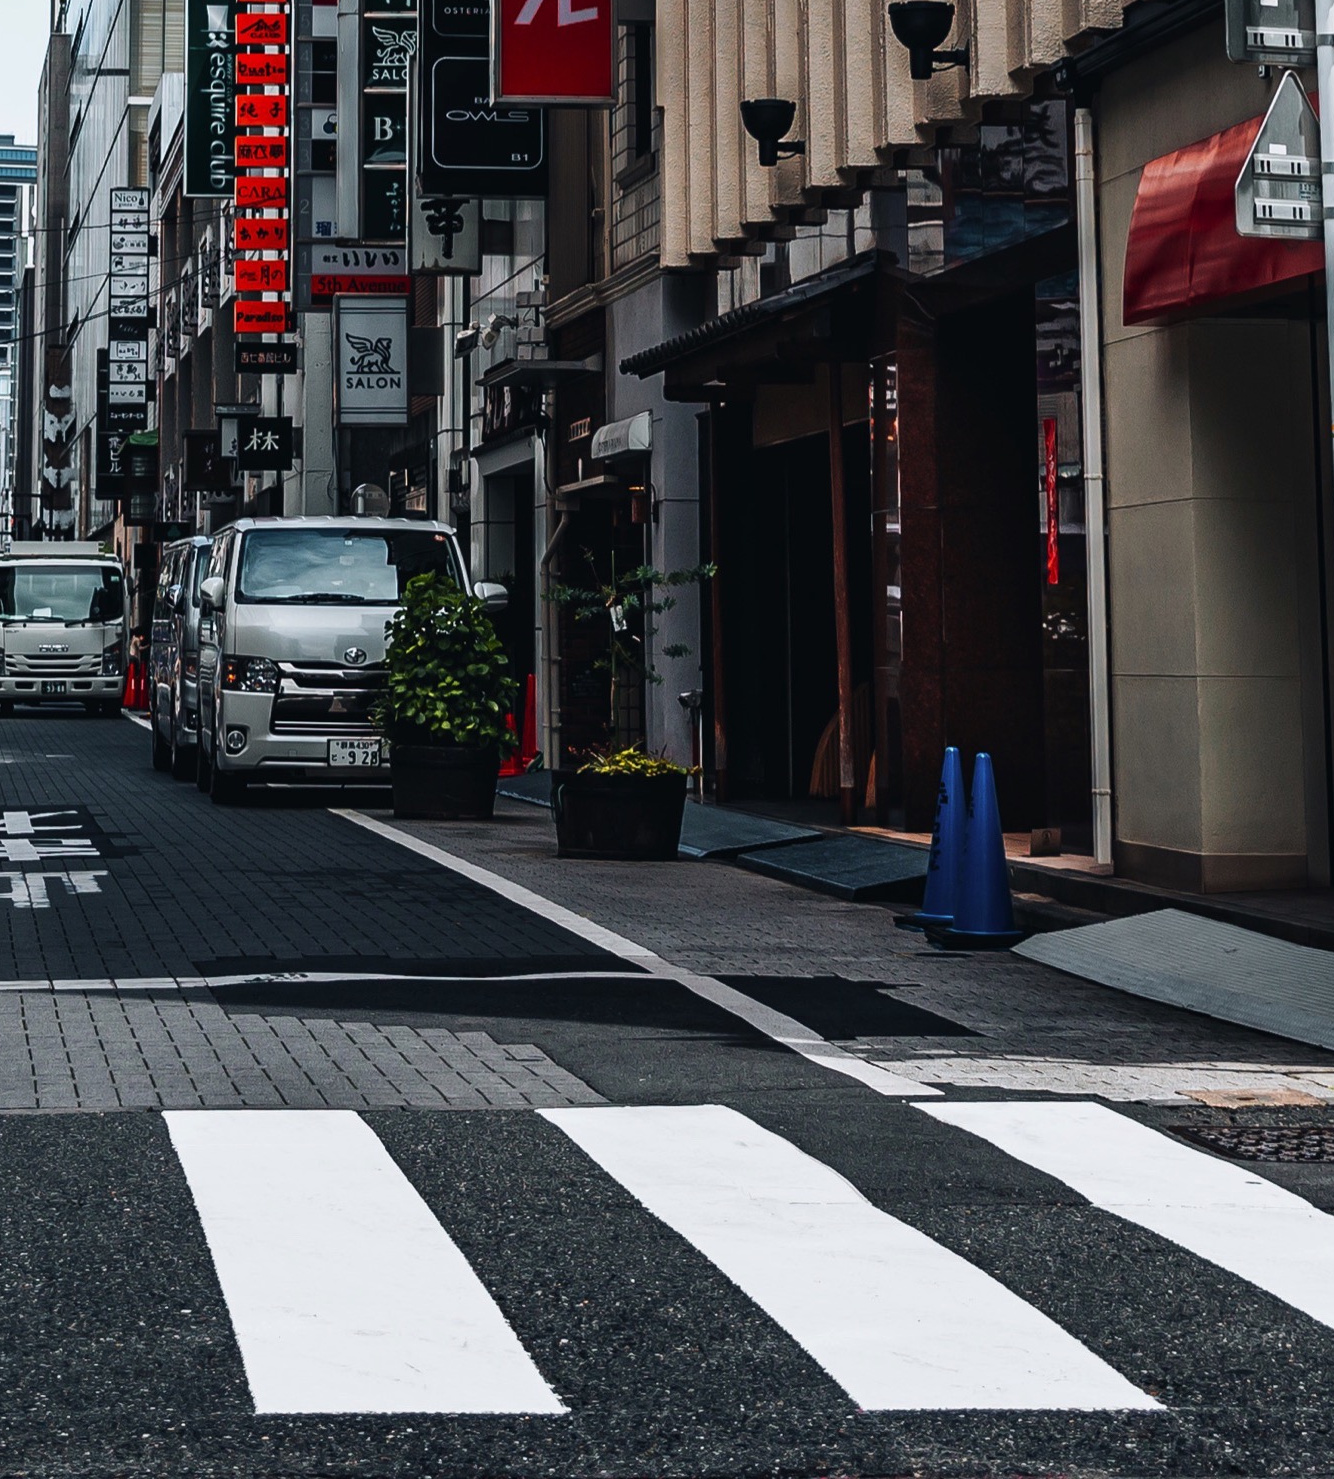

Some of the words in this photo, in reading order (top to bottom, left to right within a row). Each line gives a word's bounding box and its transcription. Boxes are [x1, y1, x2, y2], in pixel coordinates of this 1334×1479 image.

[372, 67, 409, 81] SALO
[199, 51, 231, 135] esquire
[445, 109, 530, 122] OWLS
[511, 152, 529, 163] B1
[208, 140, 234, 190] club
[114, 192, 139, 204] Nico
[239, 226, 285, 241] あかり
[317, 277, 343, 293] 5th
[349, 277, 407, 294] Avenue
[345, 376, 402, 390] SALON
[244, 427, 280, 452] 林
